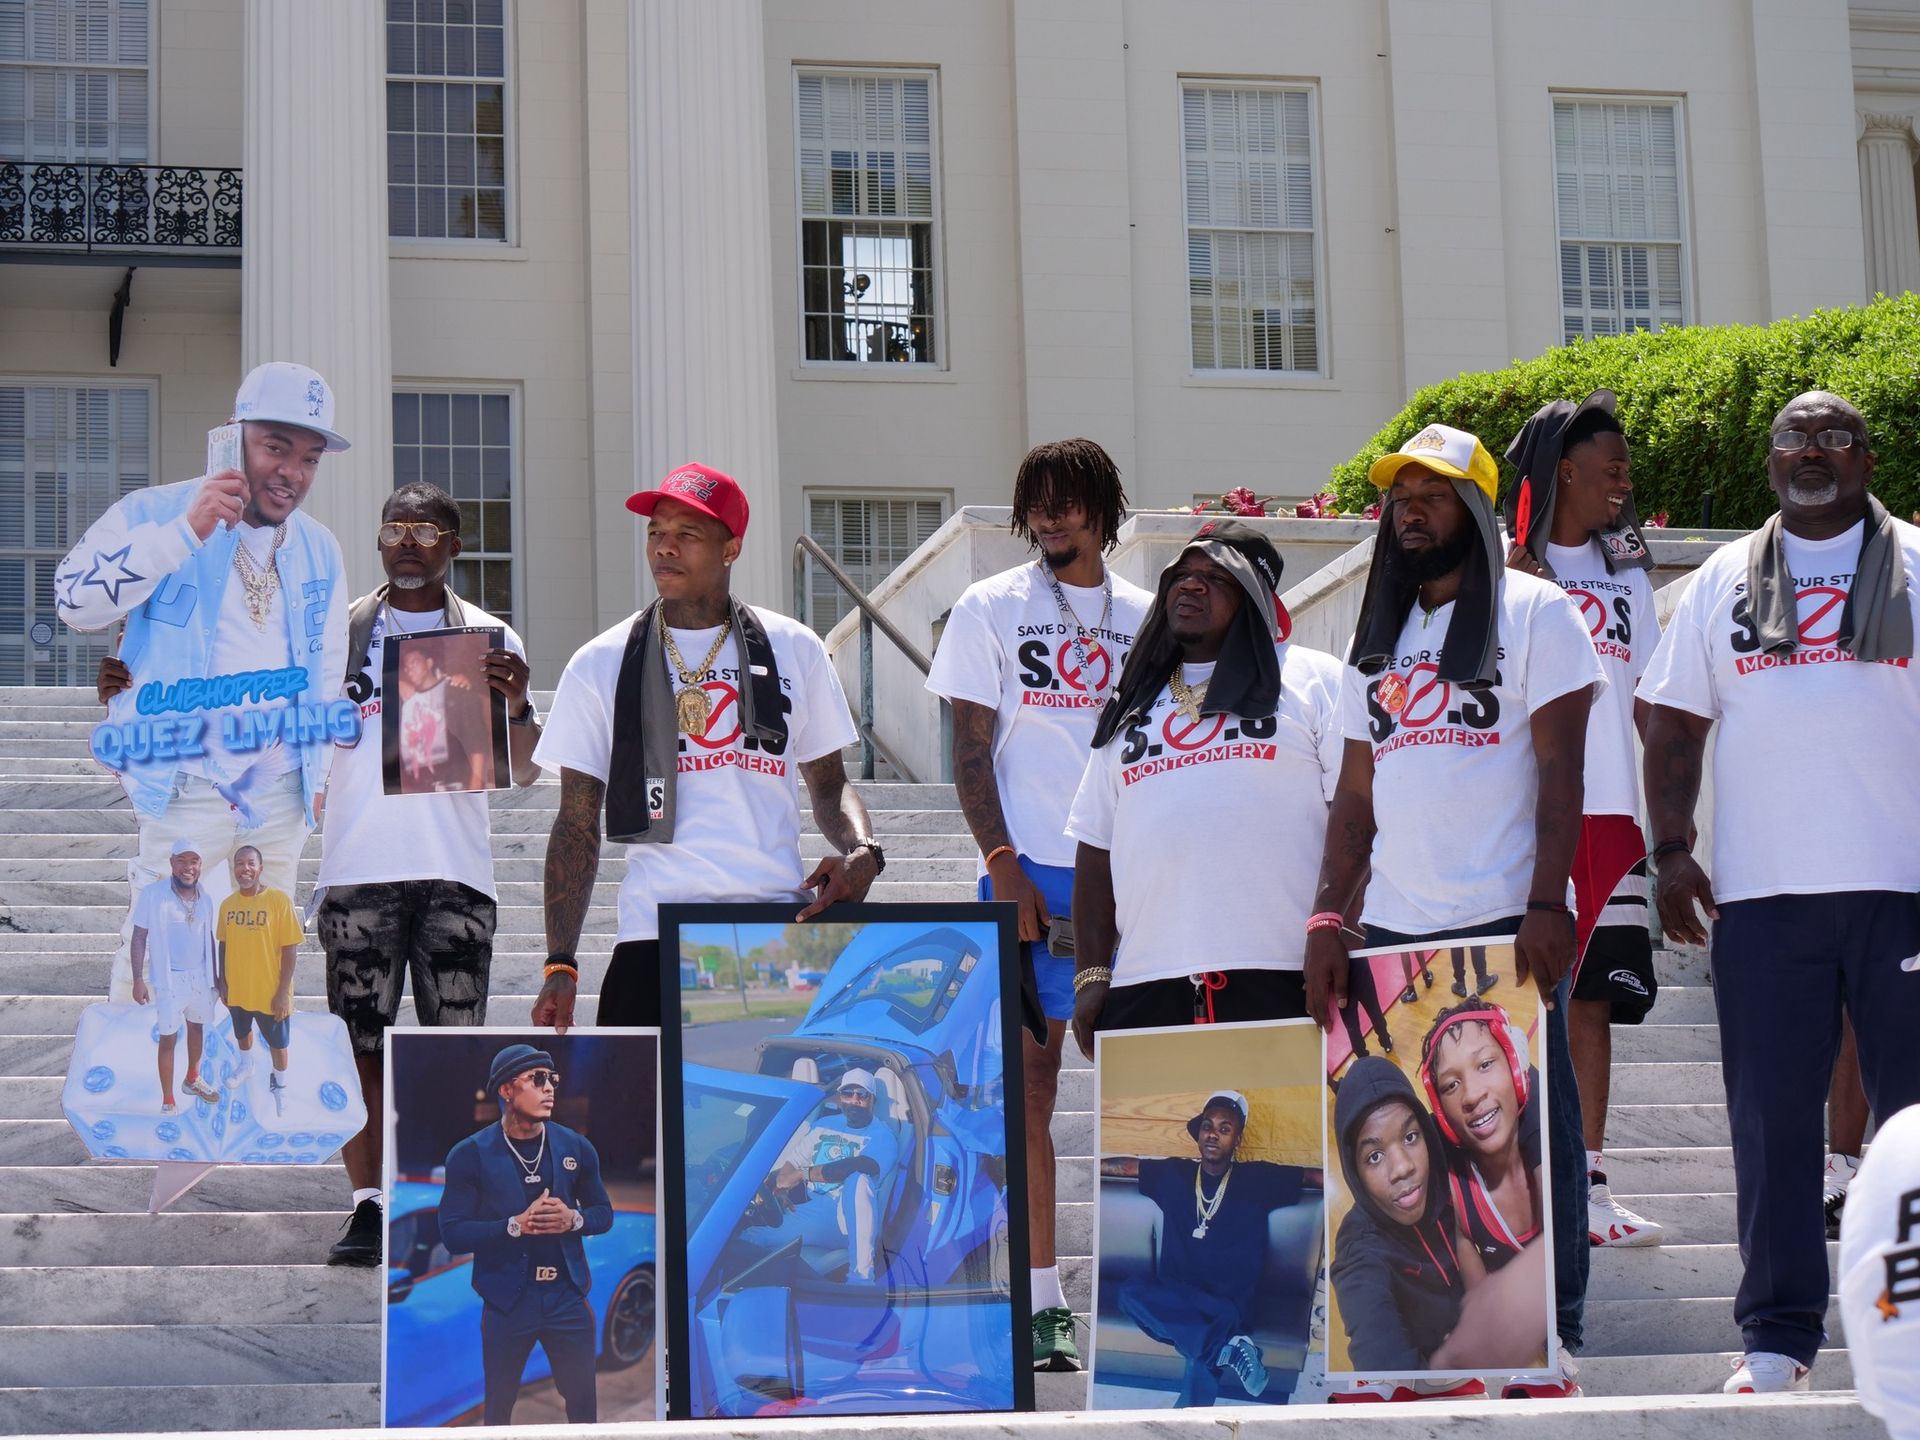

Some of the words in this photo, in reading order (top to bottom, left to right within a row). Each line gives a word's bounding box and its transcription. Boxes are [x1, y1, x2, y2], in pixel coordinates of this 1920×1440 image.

[1581, 580, 1632, 596] STREETS
[1018, 624, 1054, 637] SAVE
[137, 668, 308, 714] CLUBHOPPER
[93, 715, 206, 769] QUEZ
[223, 701, 357, 752] LIVING
[1127, 743, 1272, 784] MONTGOMERY
[227, 910, 267, 926] POLO
[536, 1266, 558, 1281] DG
